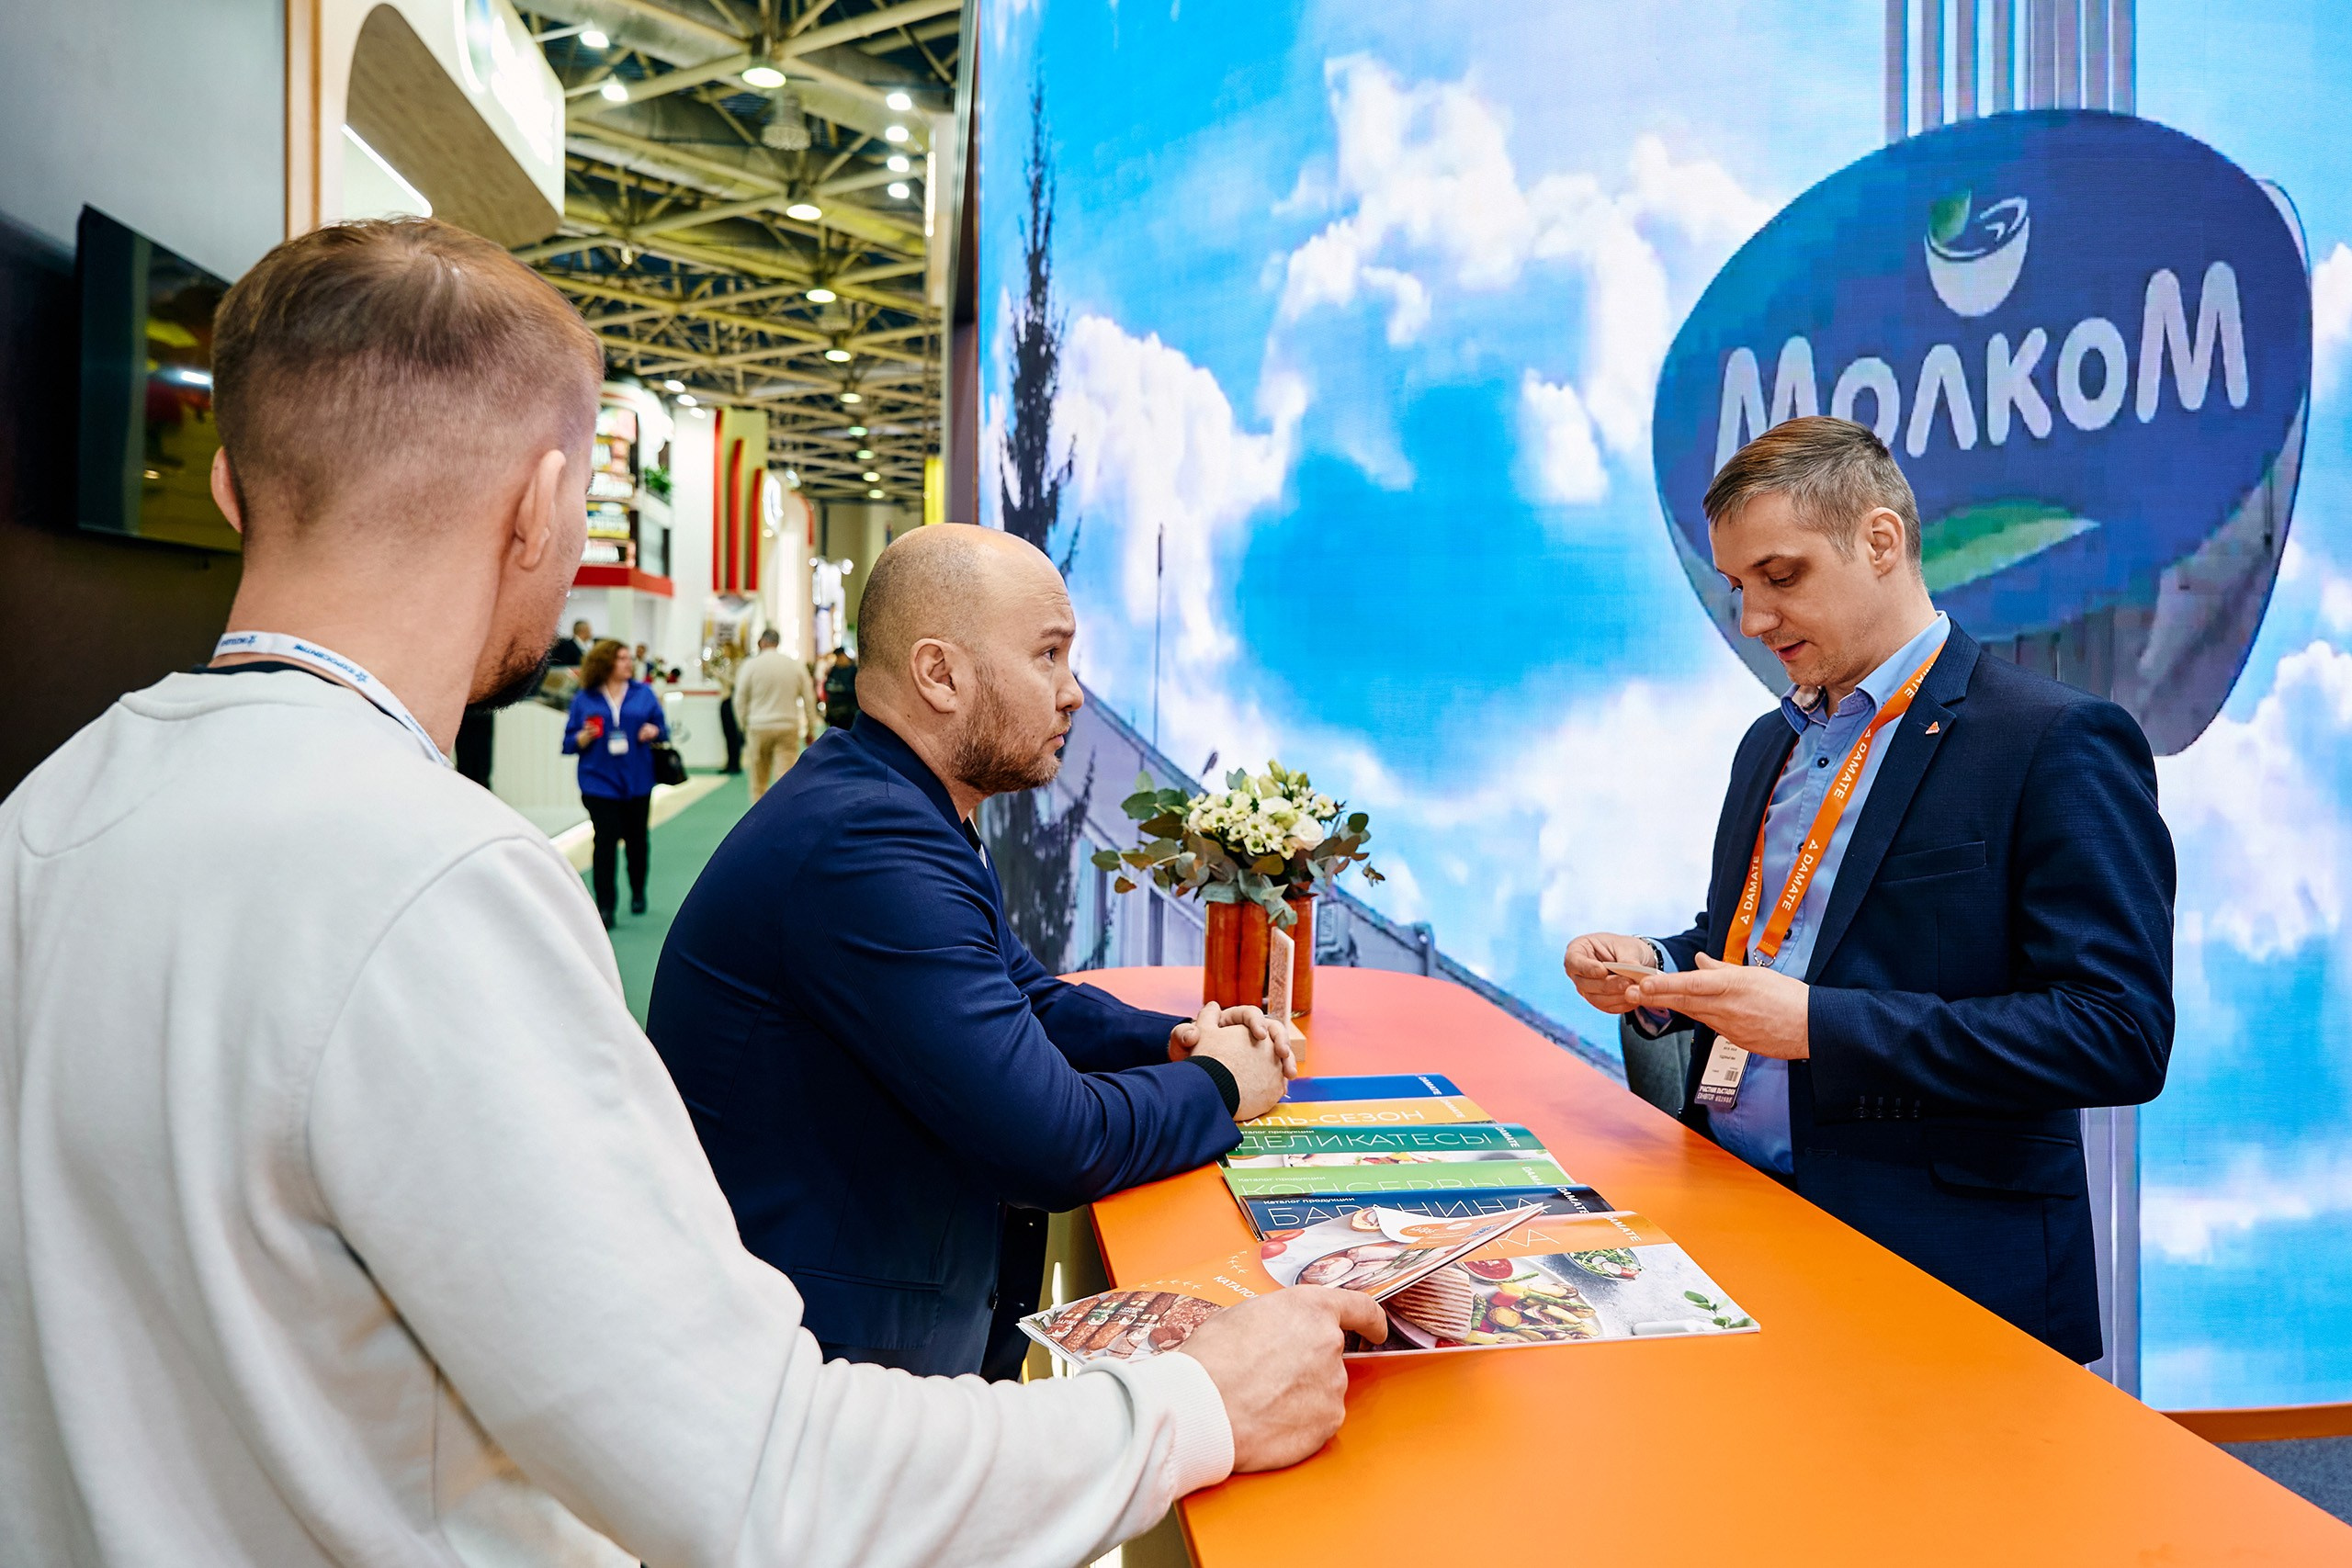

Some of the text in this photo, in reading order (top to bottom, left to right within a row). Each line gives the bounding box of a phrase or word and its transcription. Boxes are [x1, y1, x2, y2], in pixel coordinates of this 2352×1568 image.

[1833, 741, 1868, 799] DAMATE
[1743, 855, 1760, 911] DAMATE
[1781, 852, 1815, 911] DAMATE
[1418, 1075, 1442, 1096] DAMATE
[1242, 1110, 1425, 1127] ИЛЬ-СЕЗОН
[1440, 1098, 1465, 1119] DAMATE
[1235, 1133, 1493, 1151] ДЕЛИКАТЕСЫ
[1495, 1126, 1521, 1148] DAMATE
[1521, 1166, 1544, 1186] DAMA
[1556, 1186, 1590, 1214] DAMATE
[1268, 1199, 1548, 1226] БАРНИНА
[1601, 1213, 1642, 1242] DAMATE
